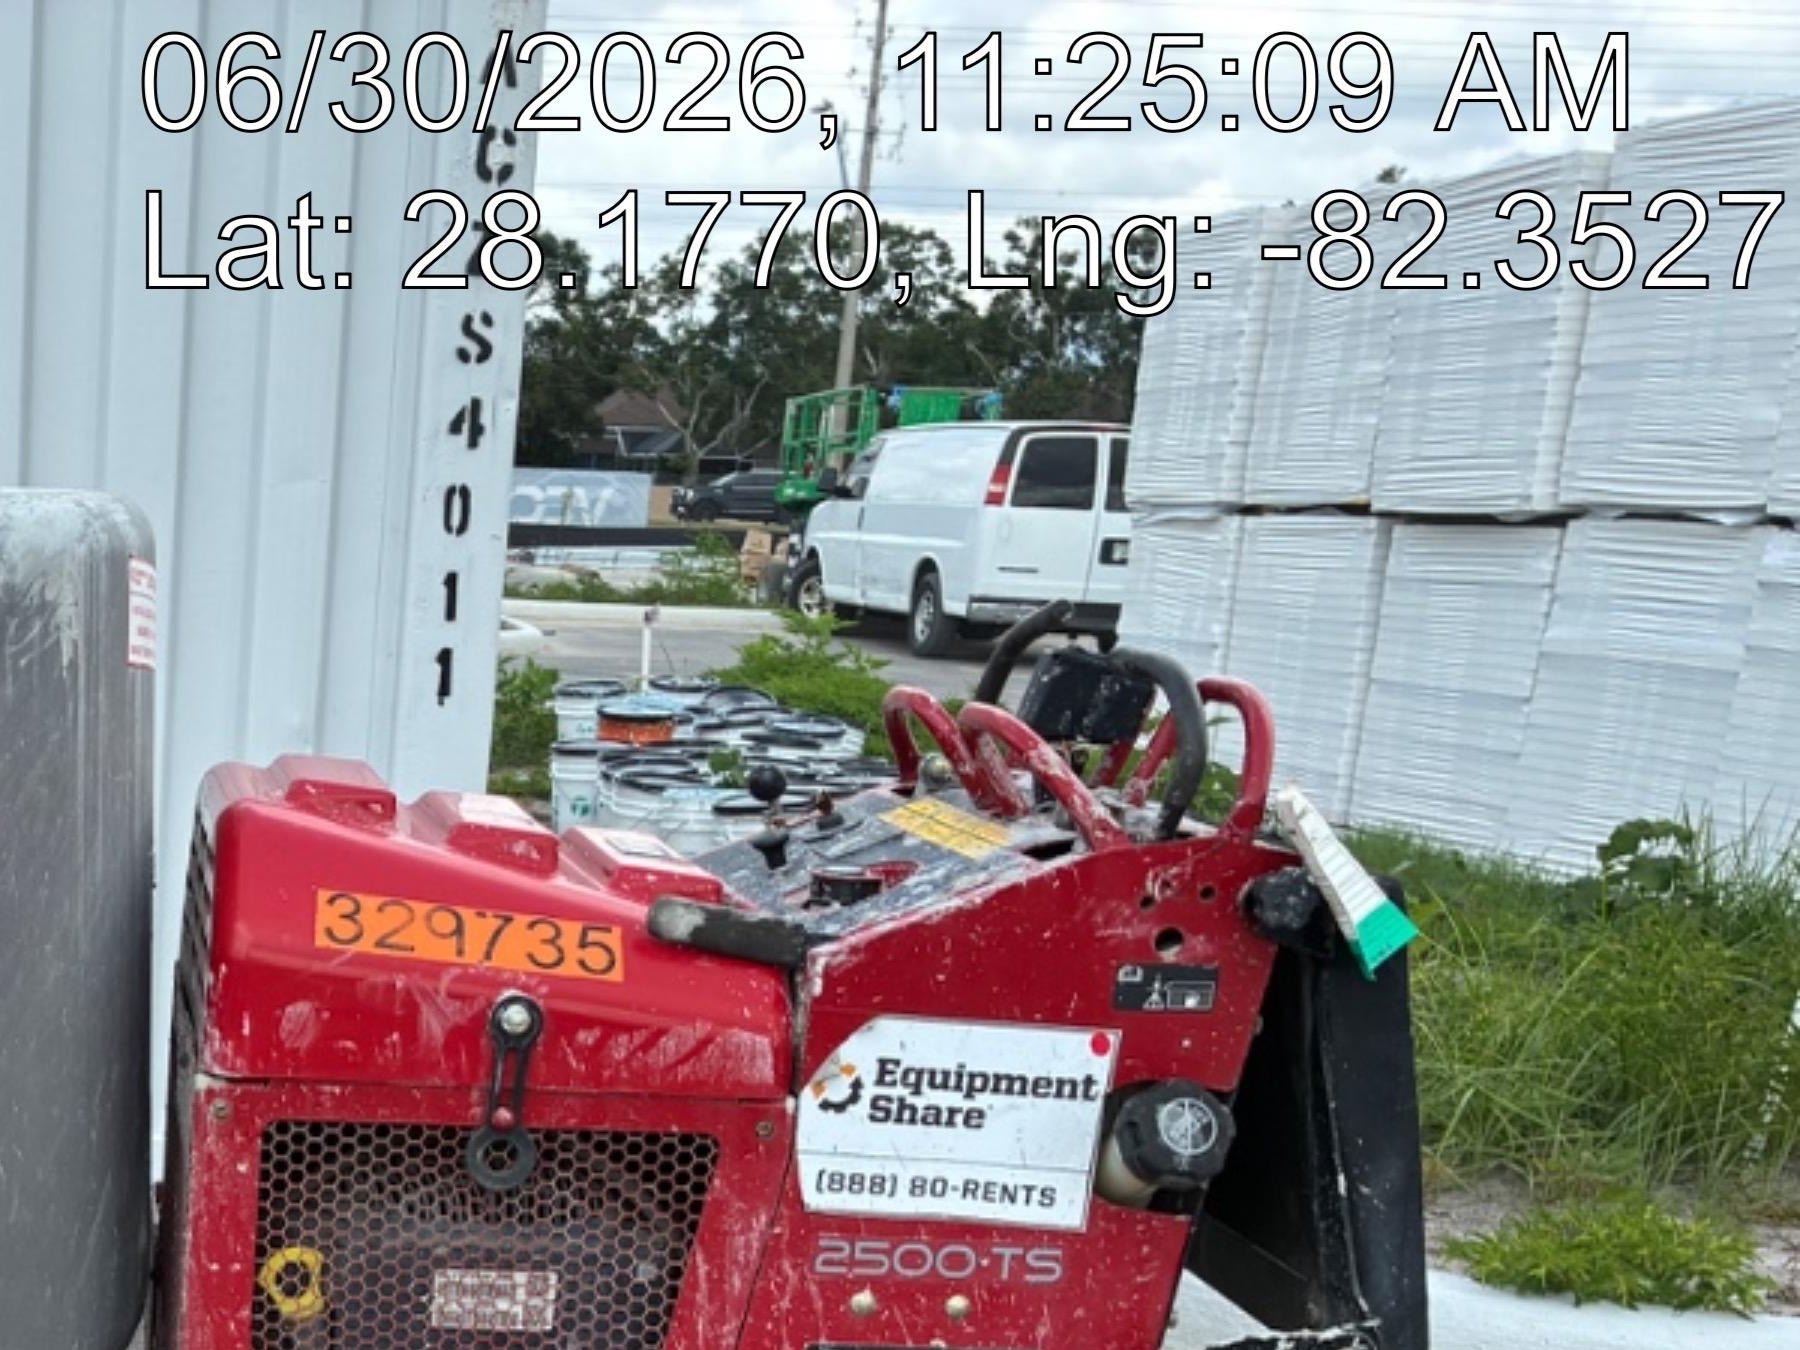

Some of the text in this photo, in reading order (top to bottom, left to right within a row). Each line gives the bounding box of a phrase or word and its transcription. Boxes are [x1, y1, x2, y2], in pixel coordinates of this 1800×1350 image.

[323, 893, 618, 976] 329735
[873, 1057, 1099, 1101] Equipment
[867, 1094, 987, 1129] Share
[814, 1168, 1057, 1208] (888) 80-RENTS
